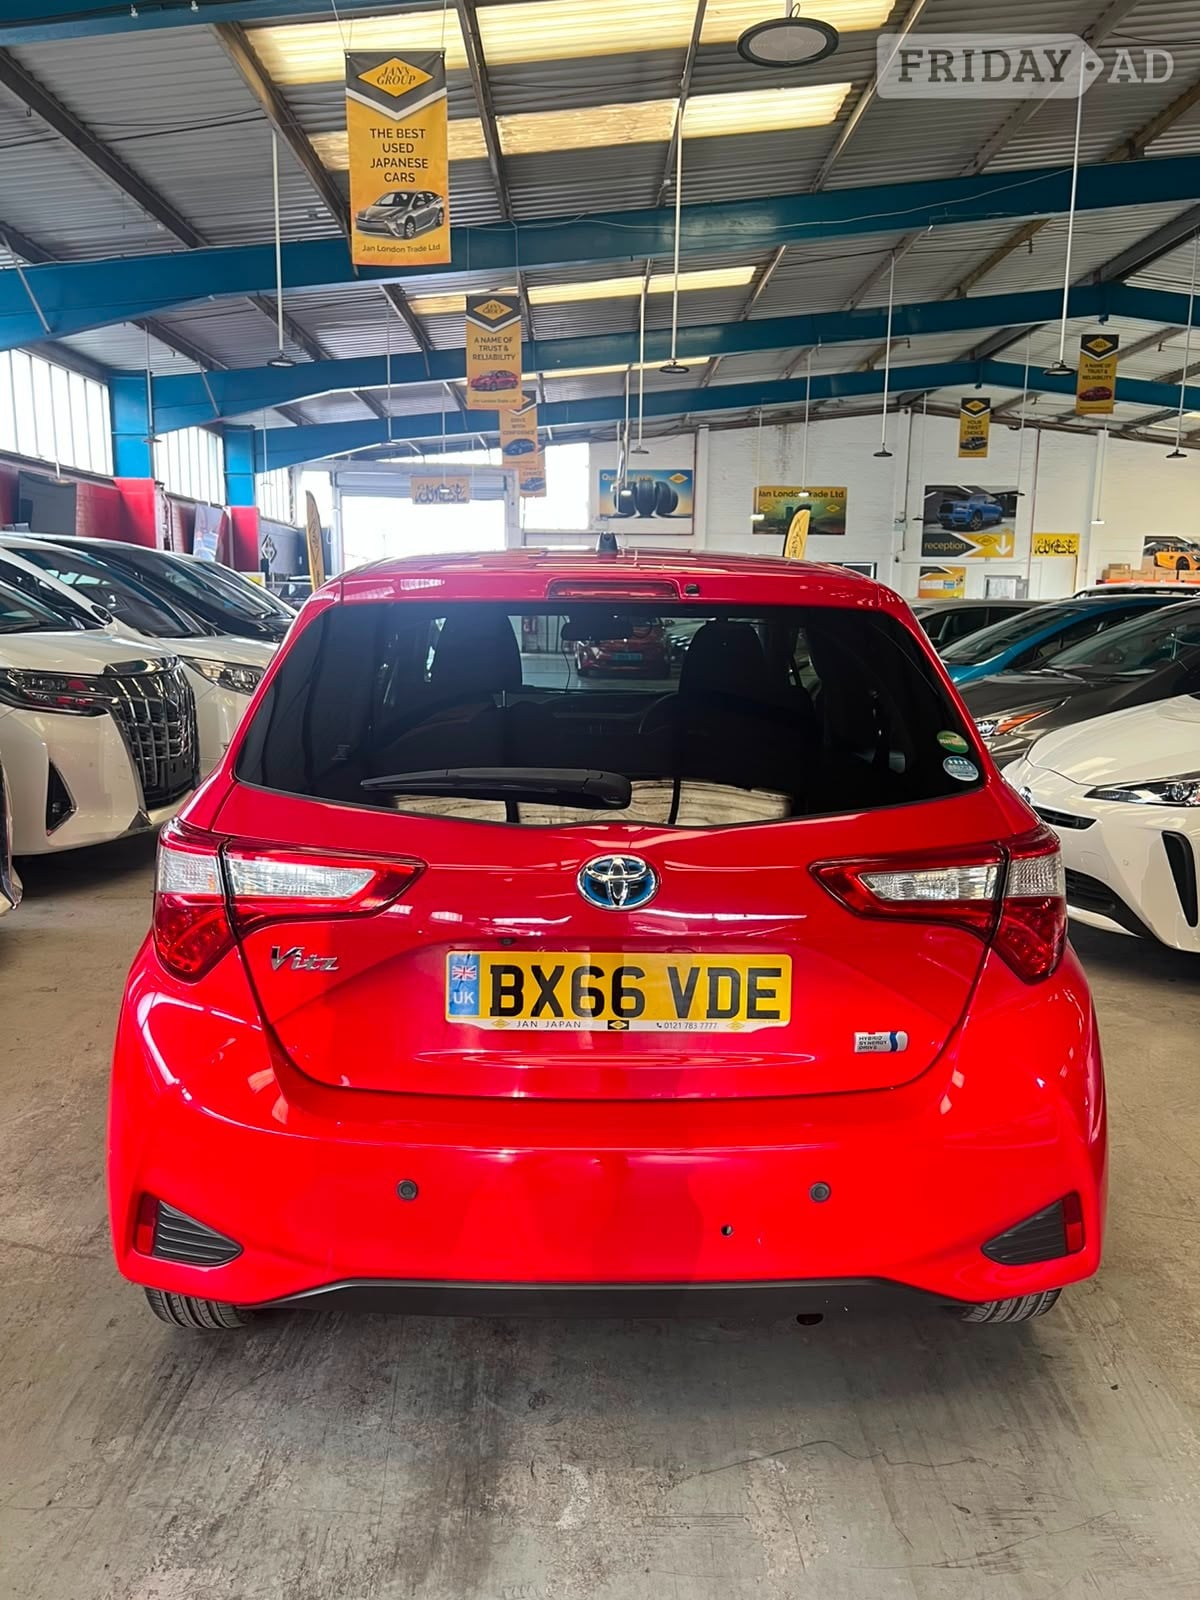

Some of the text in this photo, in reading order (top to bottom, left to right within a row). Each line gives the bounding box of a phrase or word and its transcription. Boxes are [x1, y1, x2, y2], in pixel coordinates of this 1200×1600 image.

[377, 75, 416, 85] GROUP
[369, 128, 426, 139] THE BEST
[382, 142, 415, 153] USED
[370, 157, 429, 169] JAPANESE
[384, 171, 416, 183] CARS
[362, 243, 441, 253] Jan London Trade Ltd
[480, 336, 502, 344] NAME
[479, 344, 502, 352] TRUST
[472, 353, 516, 361] RELIABILITY
[830, 490, 844, 498] Ltd
[925, 542, 966, 551] reception
[271, 946, 340, 971] Vitz
[453, 964, 782, 1020] UK BX66 VDE
[516, 1020, 538, 1029] JAN
[545, 1020, 581, 1029] JAPAN
